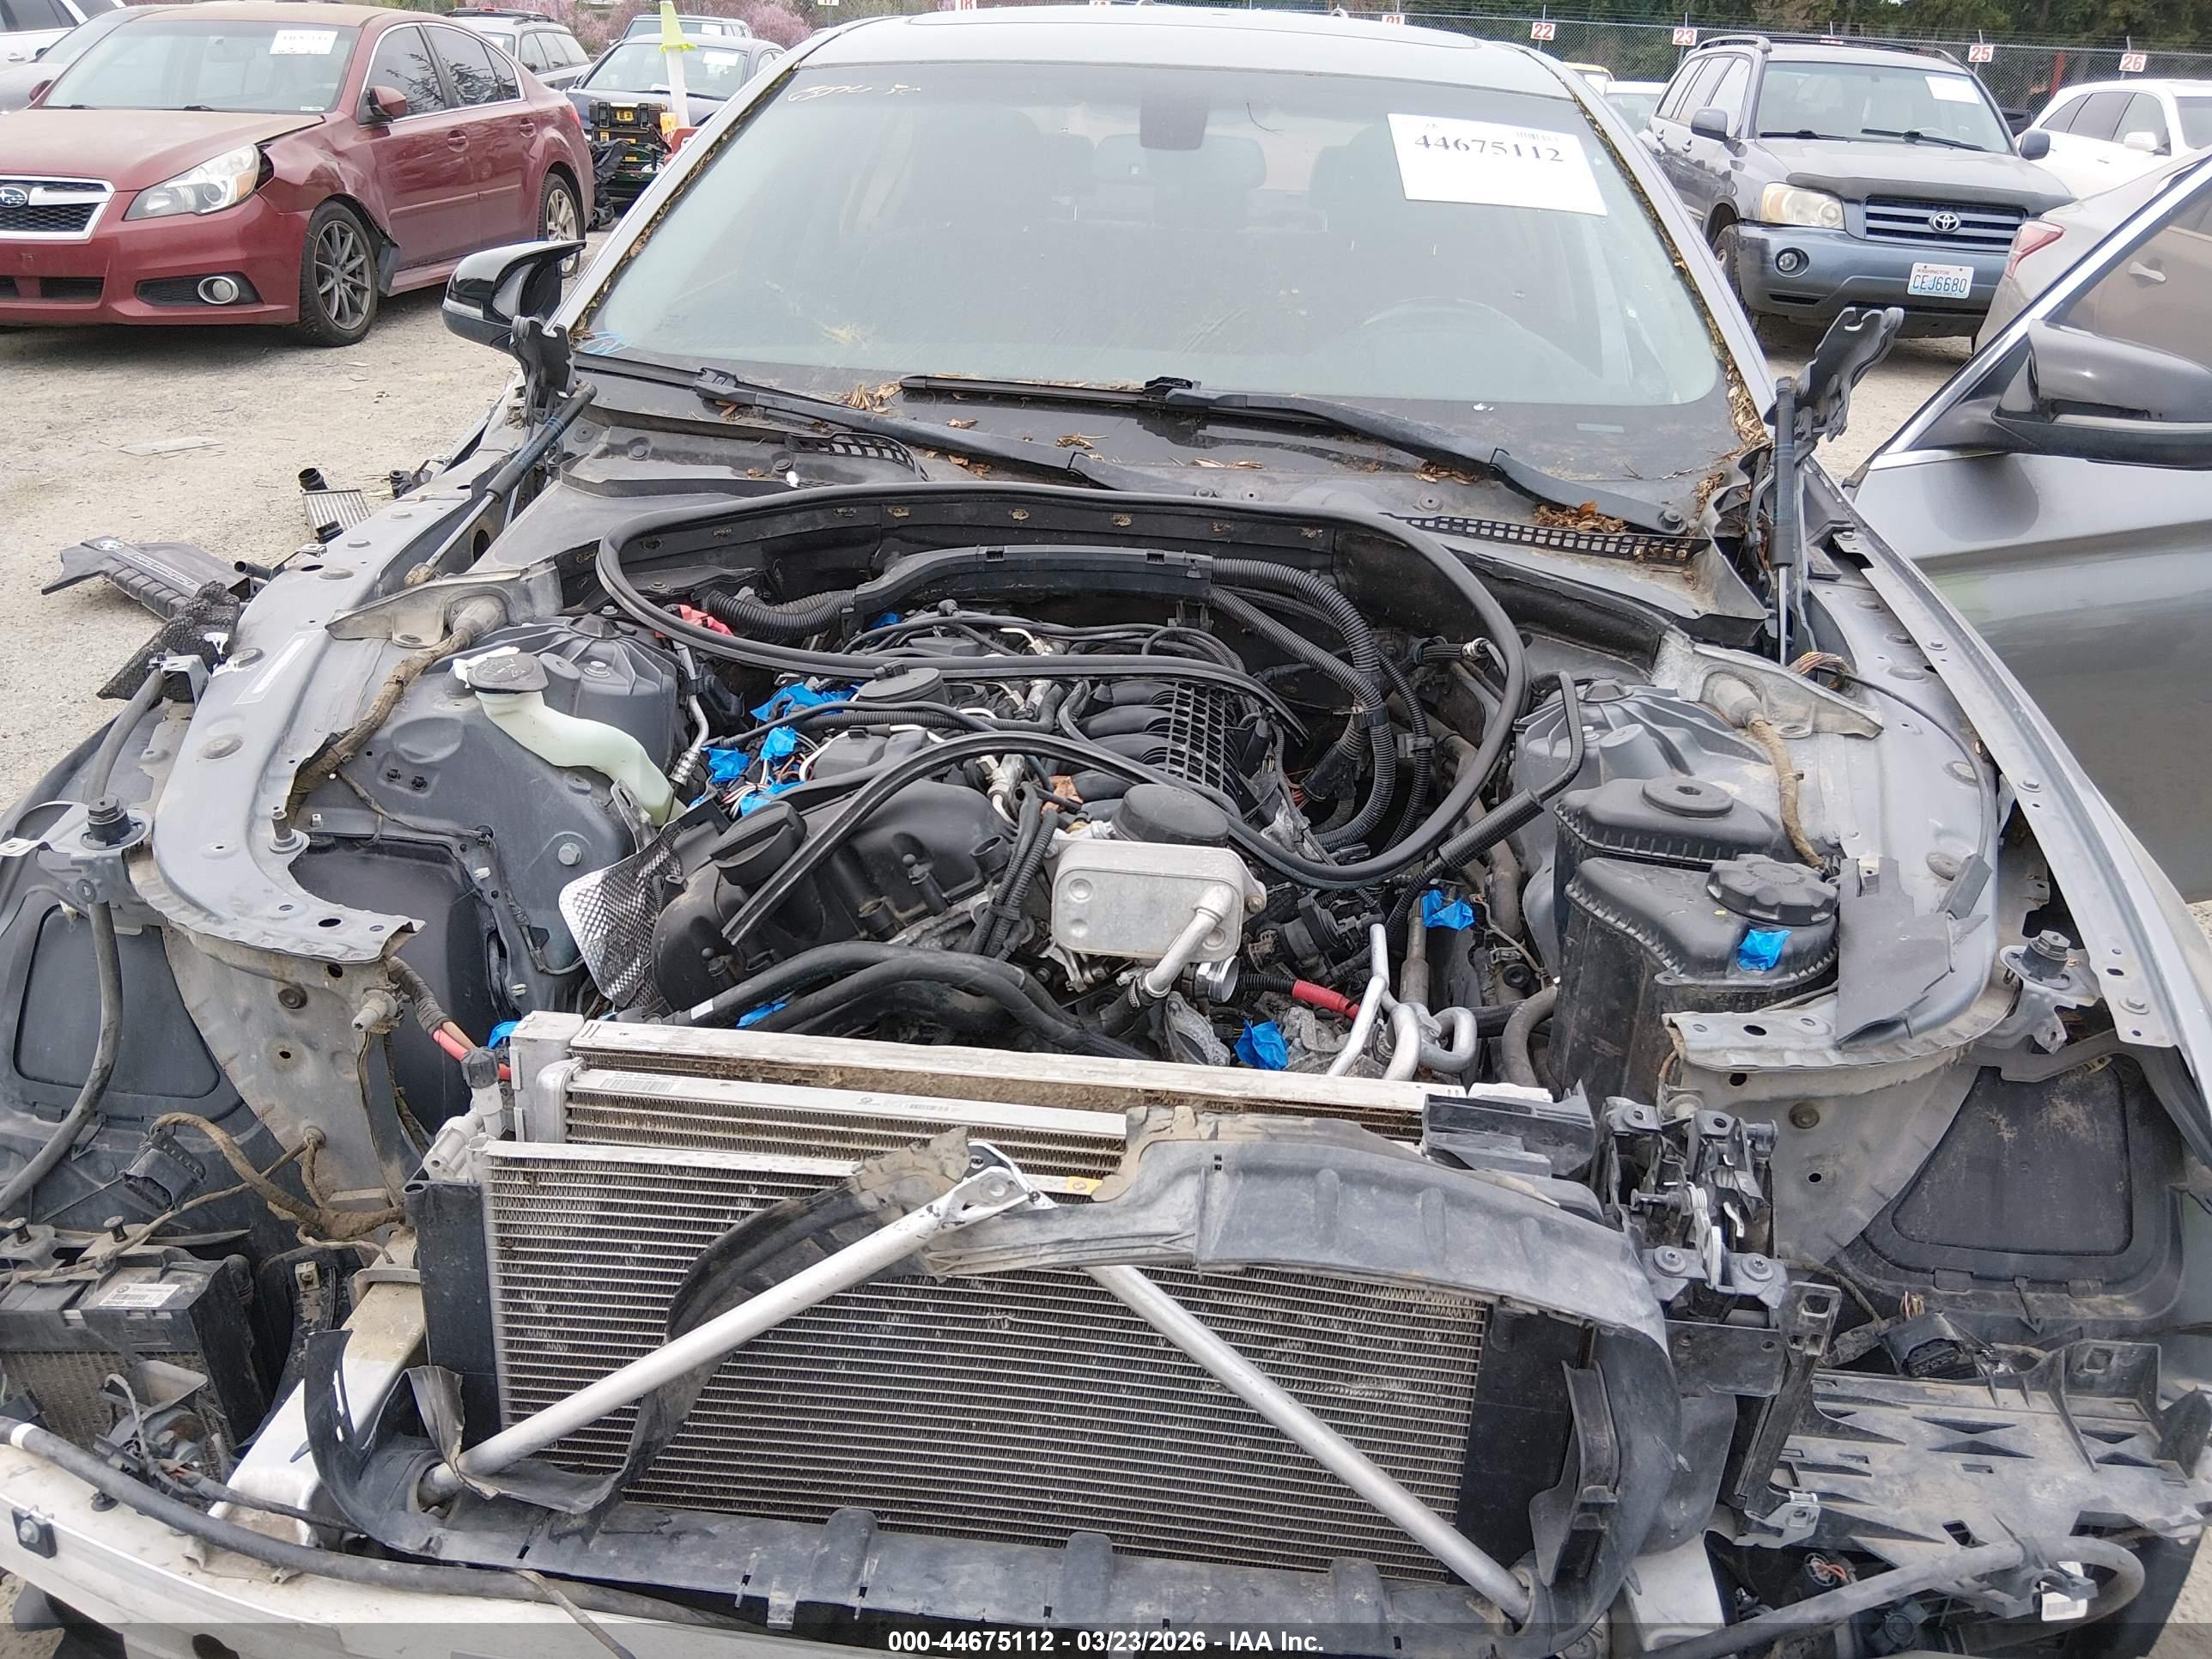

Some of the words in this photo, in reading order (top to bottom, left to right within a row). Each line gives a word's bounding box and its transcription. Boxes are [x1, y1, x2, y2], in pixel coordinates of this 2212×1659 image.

[1533, 23, 1553, 39] 22
[1675, 29, 1694, 44] 23
[1970, 46, 1990, 61] 25
[2121, 55, 2142, 70] 26
[1414, 134, 1564, 161] 44675112
[1912, 274, 1967, 293] CEJ6680
